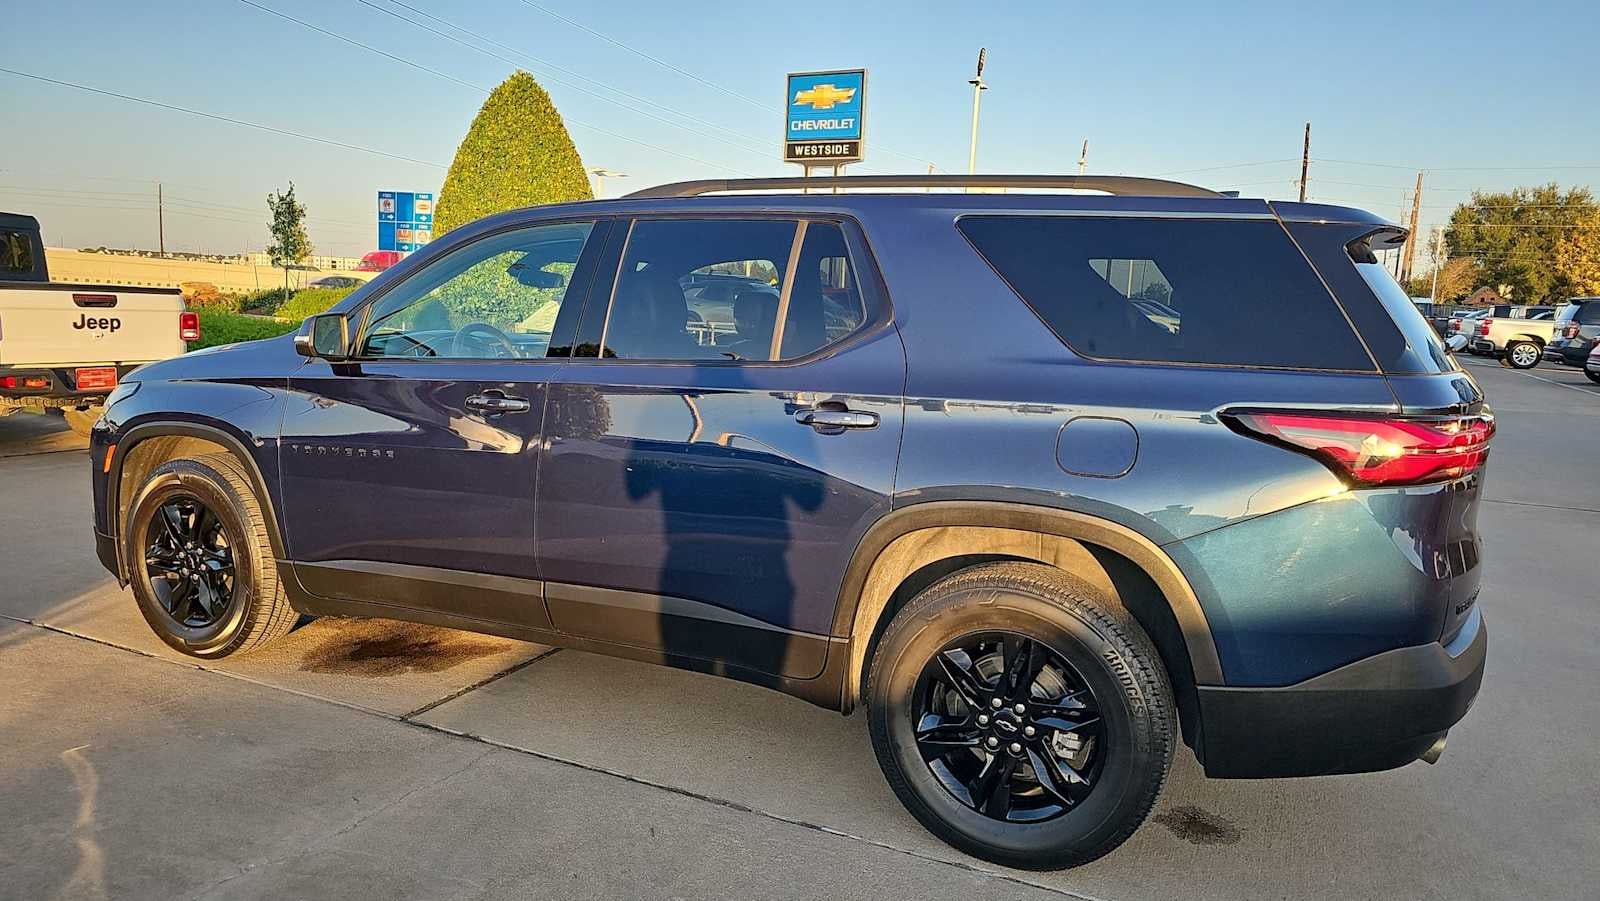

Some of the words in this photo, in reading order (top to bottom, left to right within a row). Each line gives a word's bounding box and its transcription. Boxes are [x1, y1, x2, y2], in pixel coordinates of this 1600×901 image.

[791, 118, 855, 131] CHEVROLET
[794, 144, 850, 156] WESTSIDE
[72, 313, 121, 332] Jeep
